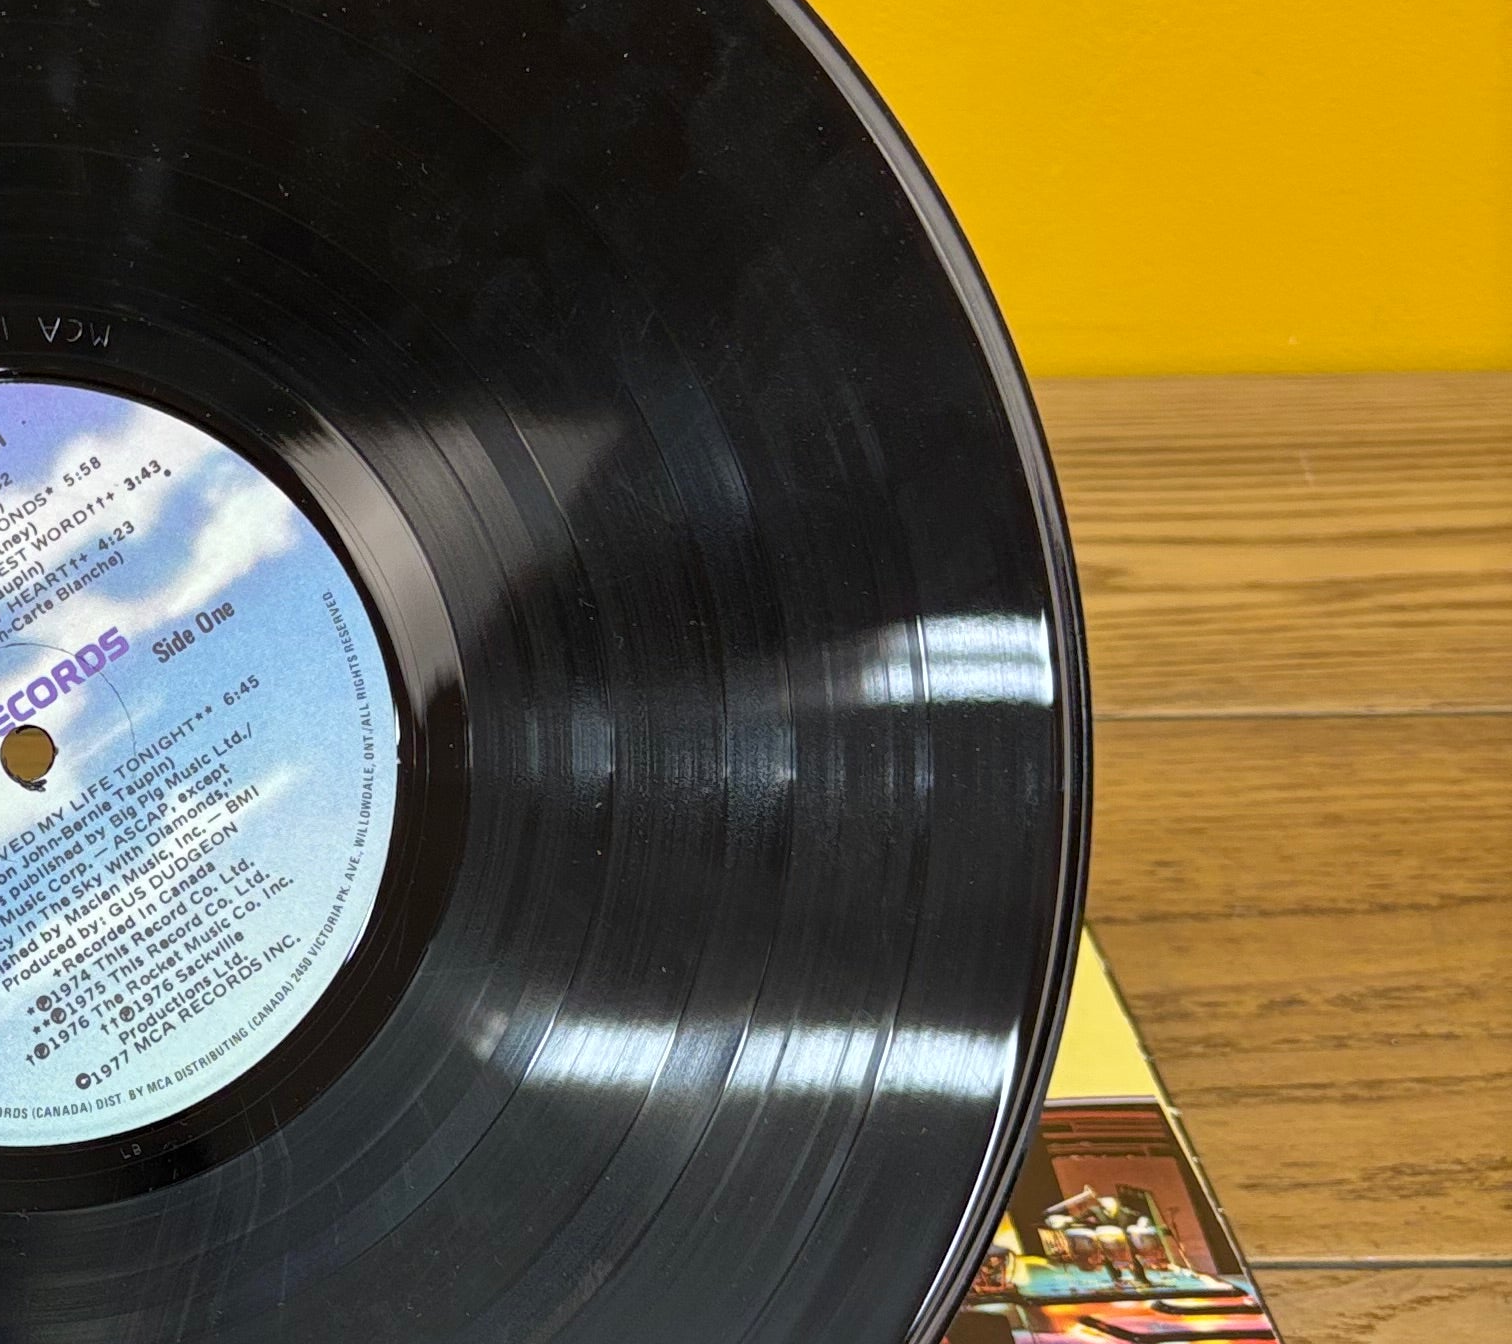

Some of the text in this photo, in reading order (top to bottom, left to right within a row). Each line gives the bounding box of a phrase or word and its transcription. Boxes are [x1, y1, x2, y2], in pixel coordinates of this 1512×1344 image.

[63, 457, 101, 487] 5:58
[123, 460, 161, 491] 3:43
[56, 551, 124, 602] Blanche)
[99, 521, 134, 550] 4:23
[152, 602, 235, 663] Side One
[37, 807, 64, 834] MY
[69, 776, 113, 812] LIFE
[223, 675, 259, 705] 6:45
[0, 891, 46, 927] Music
[48, 863, 93, 892] Corp.
[114, 803, 176, 850] ASCAP,
[178, 763, 229, 803] except
[9, 841, 84, 900] published
[84, 826, 105, 845] by
[109, 806, 137, 828] Big
[137, 787, 165, 808] Pig
[165, 754, 211, 790] Music
[22, 801, 112, 869] John-Bernie
[112, 756, 175, 802] Taupin)
[40, 924, 60, 943] by
[64, 884, 120, 926] Maclen
[122, 850, 174, 886] Music,
[175, 827, 206, 849] Inc.
[225, 785, 259, 814] BMI
[2, 821, 238, 992] Produced by: GUS DUDGEON
[17, 920, 37, 937] In
[37, 896, 71, 920] The
[72, 873, 102, 899] Sky
[104, 846, 144, 874] With
[32, 1101, 92, 1119] (CANADA)
[129, 1086, 143, 1100] BY
[147, 1076, 173, 1094] MCA
[174, 1028, 248, 1082] DISTRIBUTING
[248, 981, 294, 1031] (CANADA)
[291, 957, 312, 982] 2450
[307, 905, 343, 956] VICTORIA
[347, 655, 367, 700] RIGHTS
[53, 862, 216, 977] +Recorded In Canada
[92, 944, 129, 971] This
[130, 901, 188, 947] Record
[190, 886, 218, 905] Co.
[219, 858, 255, 884] Ltd.
[107, 956, 144, 983] This
[146, 913, 203, 958] Record
[205, 898, 233, 917] Co.
[234, 870, 270, 896] Ltd.
[91, 993, 124, 1018] The
[125, 950, 183, 995] Rocket
[184, 918, 231, 954] Music
[233, 901, 261, 920] Co.
[262, 877, 294, 899] Inc.
[118, 952, 248, 1045] Productions Ltd.
[134, 1021, 176, 1054] MCA
[178, 958, 262, 1023] RECORDS
[263, 935, 301, 962] INC.
[175, 931, 244, 983] Sackville
